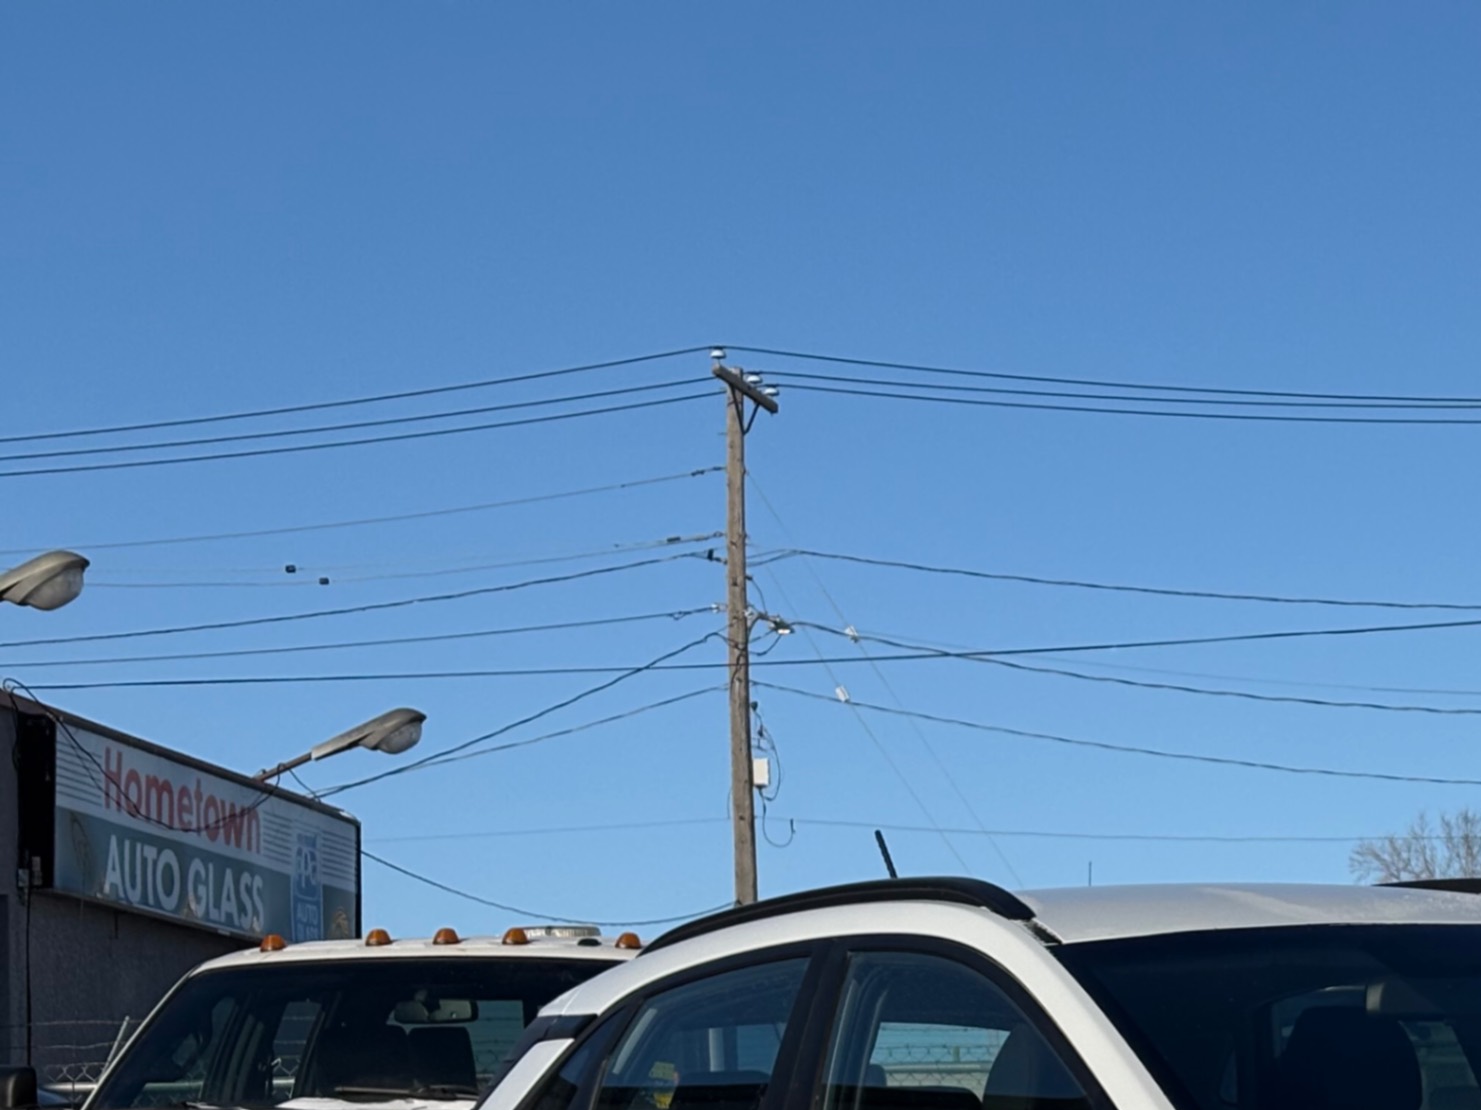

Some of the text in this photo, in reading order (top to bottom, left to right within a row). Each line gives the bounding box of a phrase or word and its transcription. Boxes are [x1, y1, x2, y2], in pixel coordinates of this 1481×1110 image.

[104, 747, 261, 854] Hometown
[103, 834, 265, 932] AUTO GLASS
